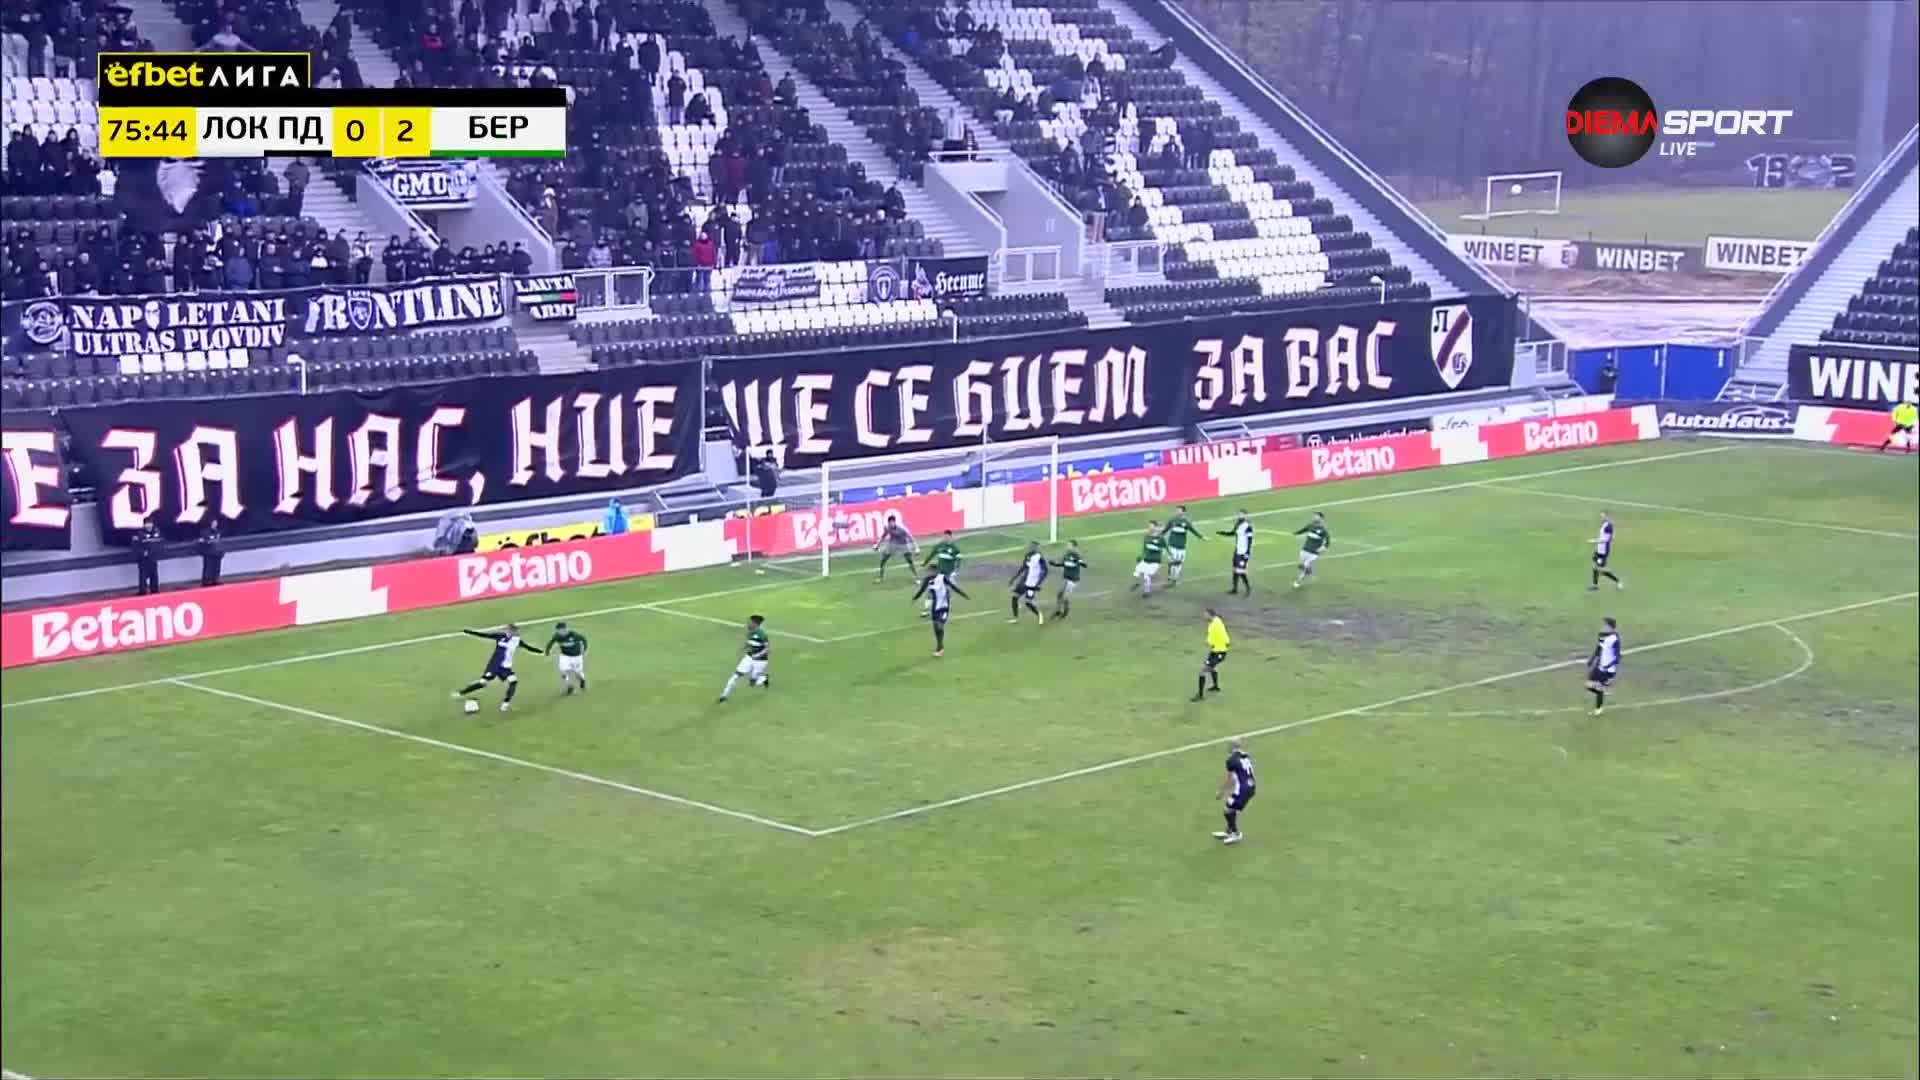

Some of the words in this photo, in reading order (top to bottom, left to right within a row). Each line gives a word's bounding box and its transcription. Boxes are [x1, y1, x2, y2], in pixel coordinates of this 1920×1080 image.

[1463, 239, 1544, 264] WINBET
[1596, 246, 1685, 273] WINBET
[1716, 242, 1809, 267] WINBET
[514, 275, 575, 293] LAUTA
[73, 328, 176, 356] ULTRAS
[182, 324, 286, 351] PLOVDIV
[855, 365, 934, 449] СЕ
[1192, 334, 1267, 411] ЗА
[1283, 320, 1397, 400] ВАС
[1523, 419, 1598, 452] Betano
[1659, 411, 1783, 430] AutoHaus
[1311, 445, 1395, 481] Betano
[1071, 474, 1167, 513] Betano
[791, 508, 902, 550] Betano
[457, 541, 593, 598] Betano
[31, 600, 204, 659] Betano
